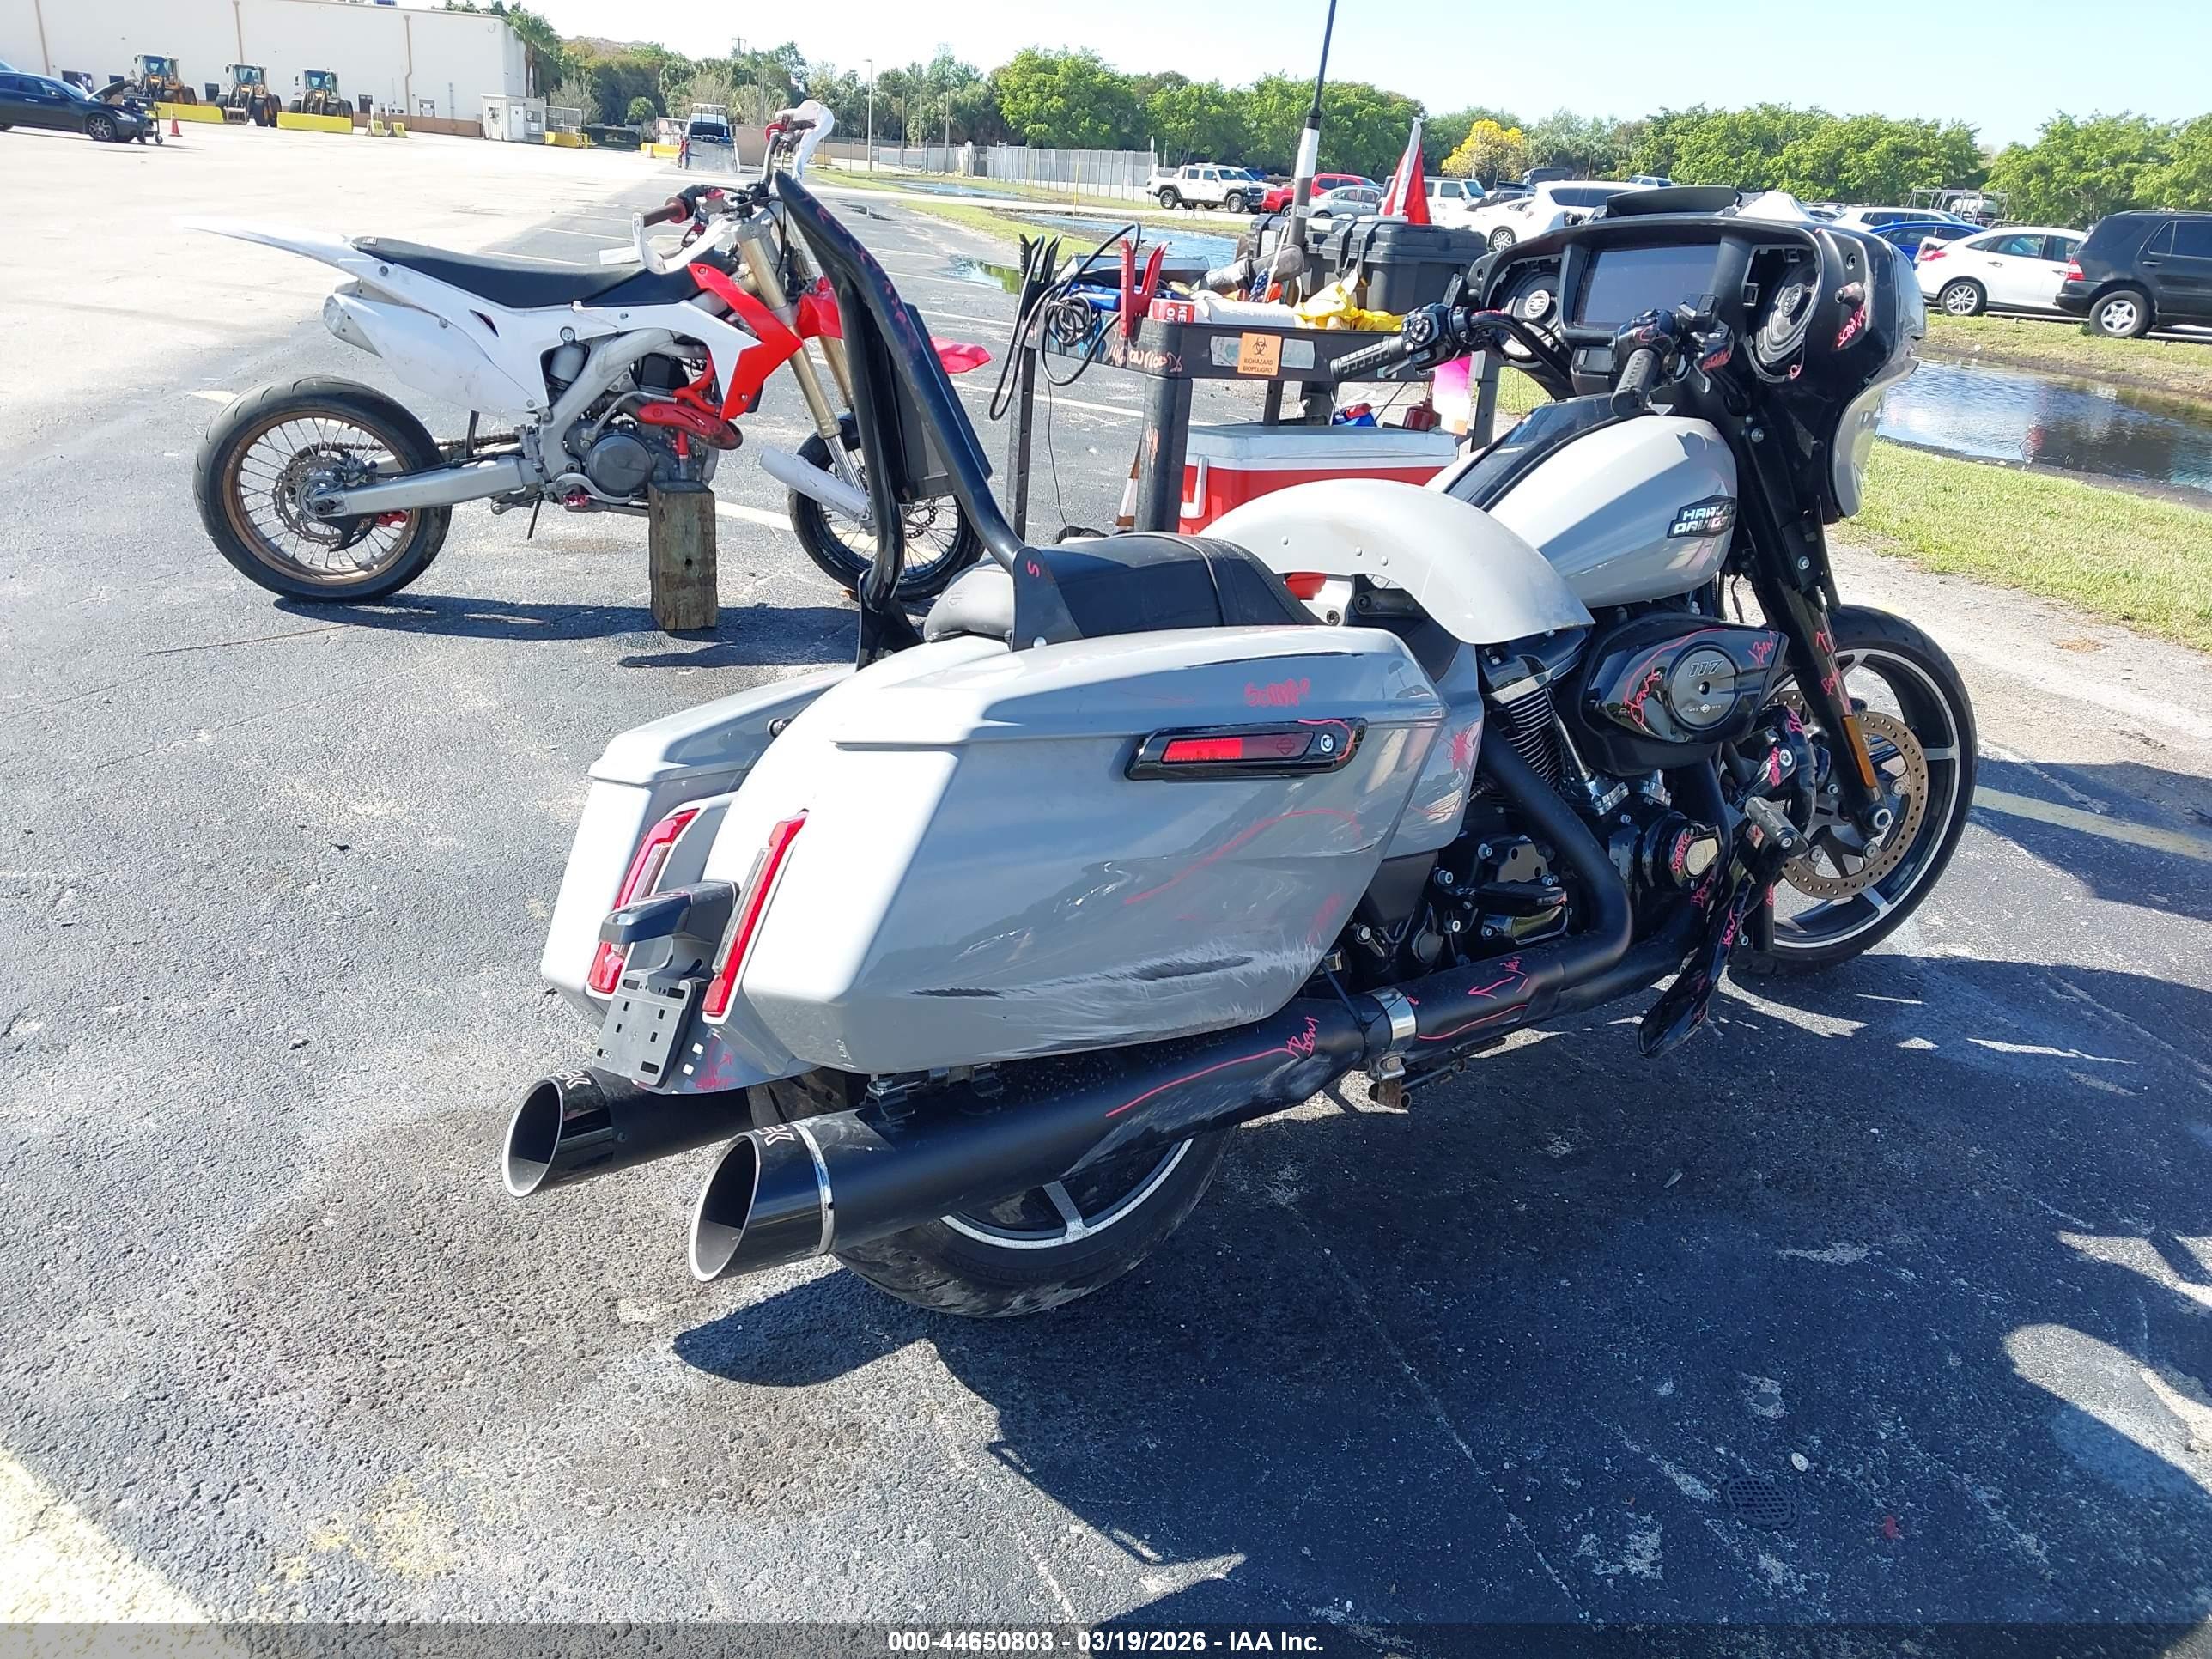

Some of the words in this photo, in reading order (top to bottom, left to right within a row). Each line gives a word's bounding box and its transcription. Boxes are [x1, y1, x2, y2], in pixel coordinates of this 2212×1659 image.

[1243, 357, 1273, 366] BIOHAZARD
[1673, 515, 1732, 536] DAVIDS
[1688, 659, 1725, 678] 117
